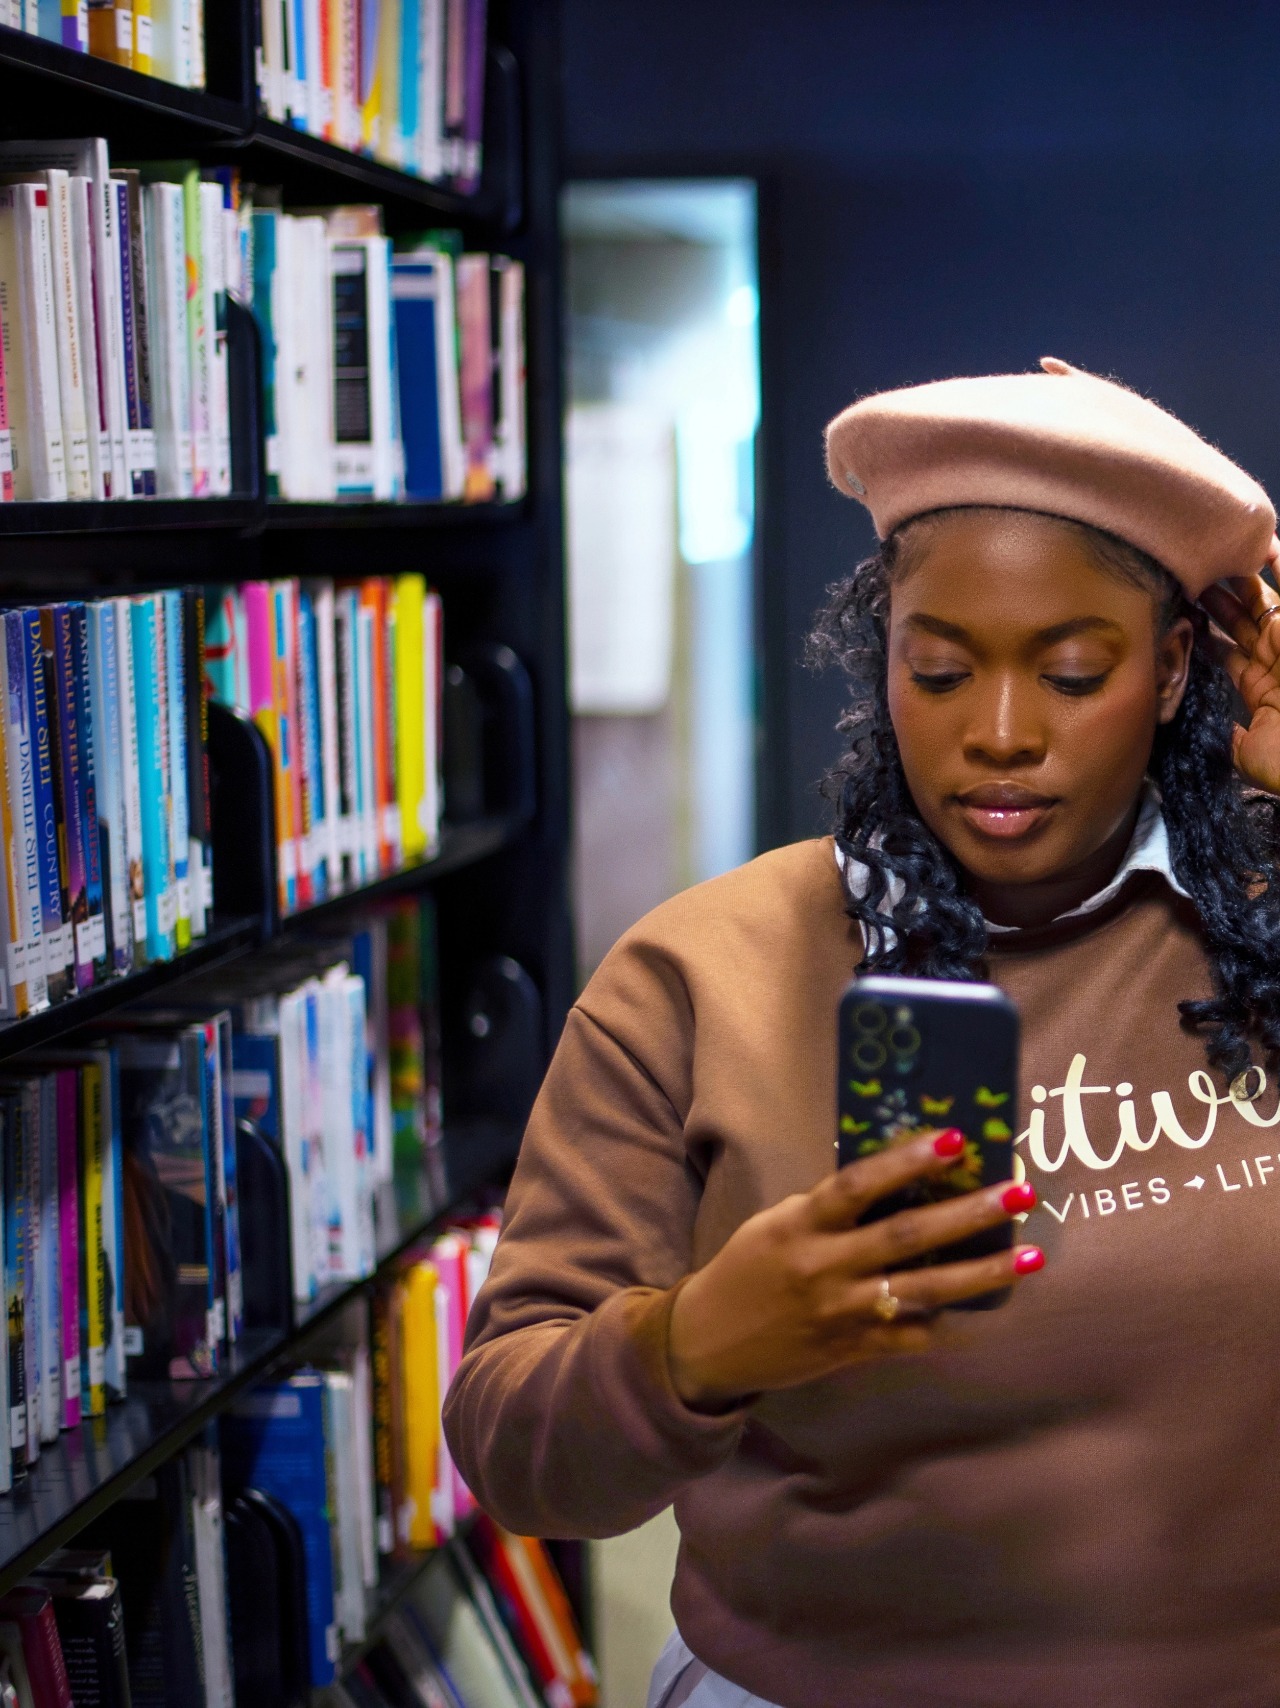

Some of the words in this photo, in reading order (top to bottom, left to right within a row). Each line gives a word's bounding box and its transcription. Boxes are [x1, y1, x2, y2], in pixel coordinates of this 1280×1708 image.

[29, 620, 47, 723] DANIELLE
[61, 613, 76, 705] DANIELLE
[80, 618, 93, 714] DANIELLE
[37, 726, 52, 790] STEEL
[67, 719, 80, 778] STEEL
[85, 717, 96, 777] STEEL
[20, 740, 34, 835] DANIELLE
[25, 837, 39, 896] STEEL
[43, 802, 60, 917] COUNTRY
[1042, 1177, 1171, 1223] VIBES
